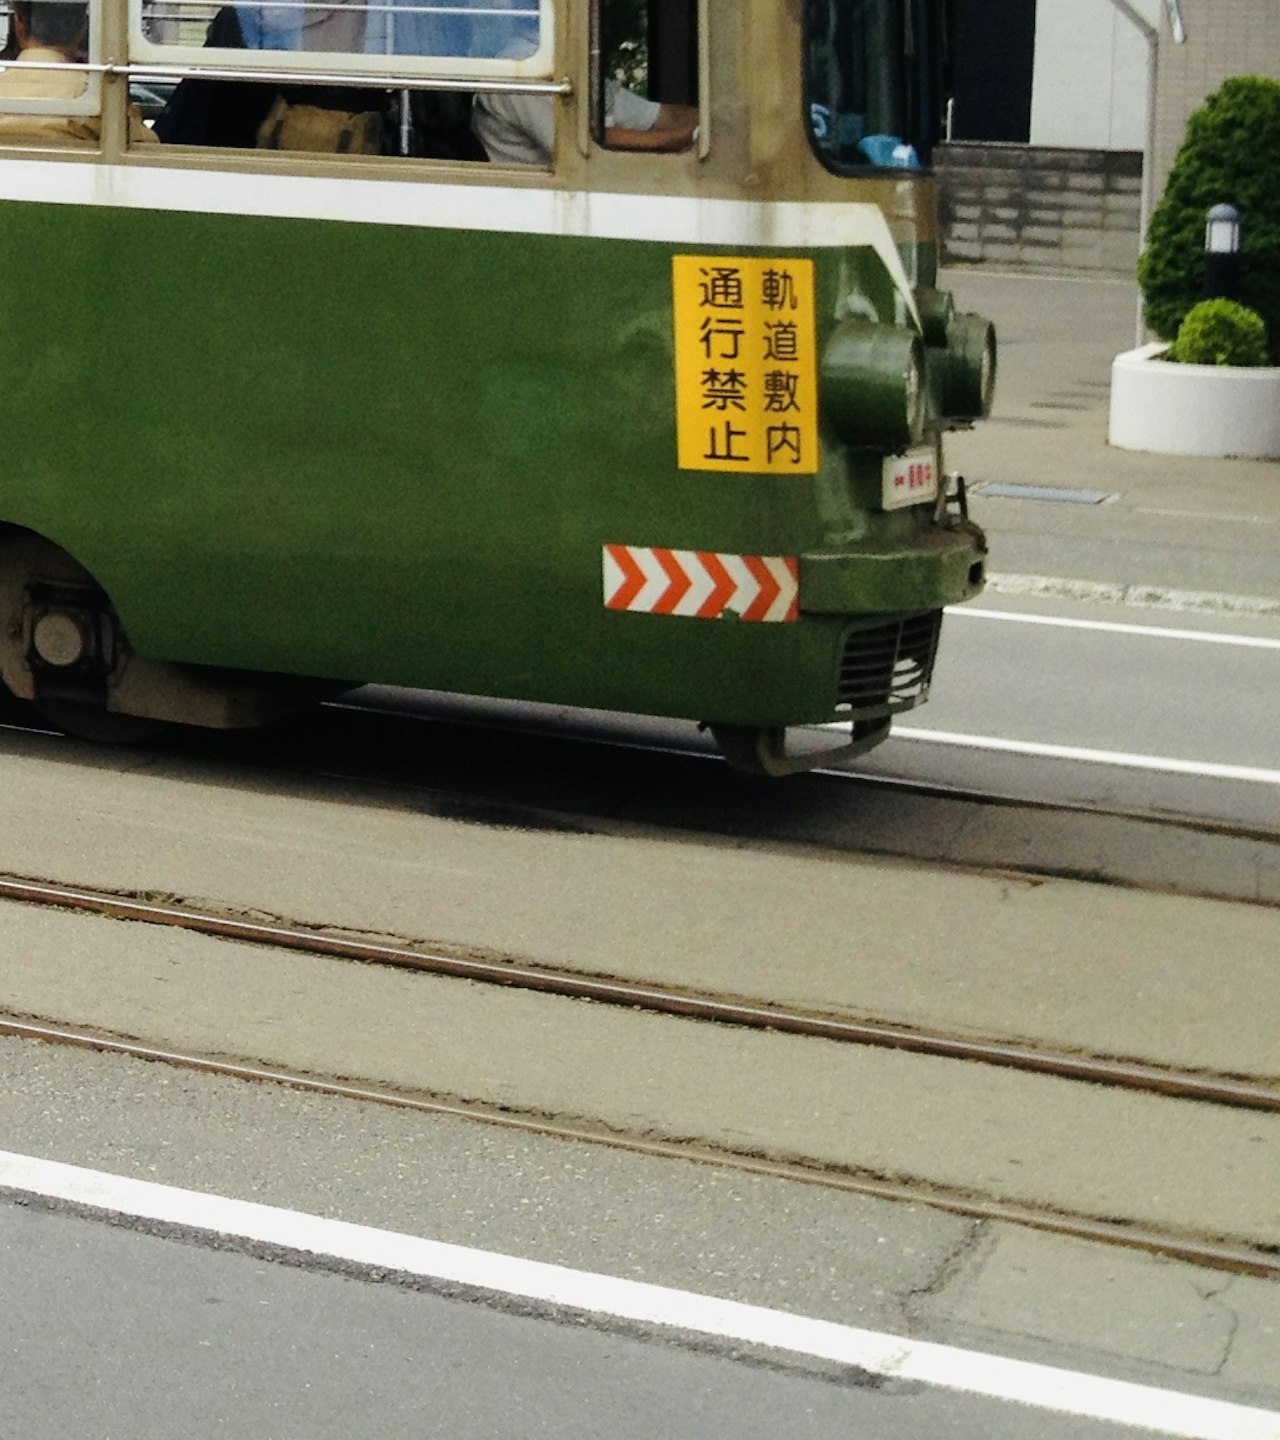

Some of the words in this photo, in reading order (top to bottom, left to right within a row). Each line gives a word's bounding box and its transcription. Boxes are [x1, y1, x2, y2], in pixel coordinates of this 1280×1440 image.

[698, 267, 749, 462] 通行禁止
[761, 269, 802, 465] 軌道敷内
